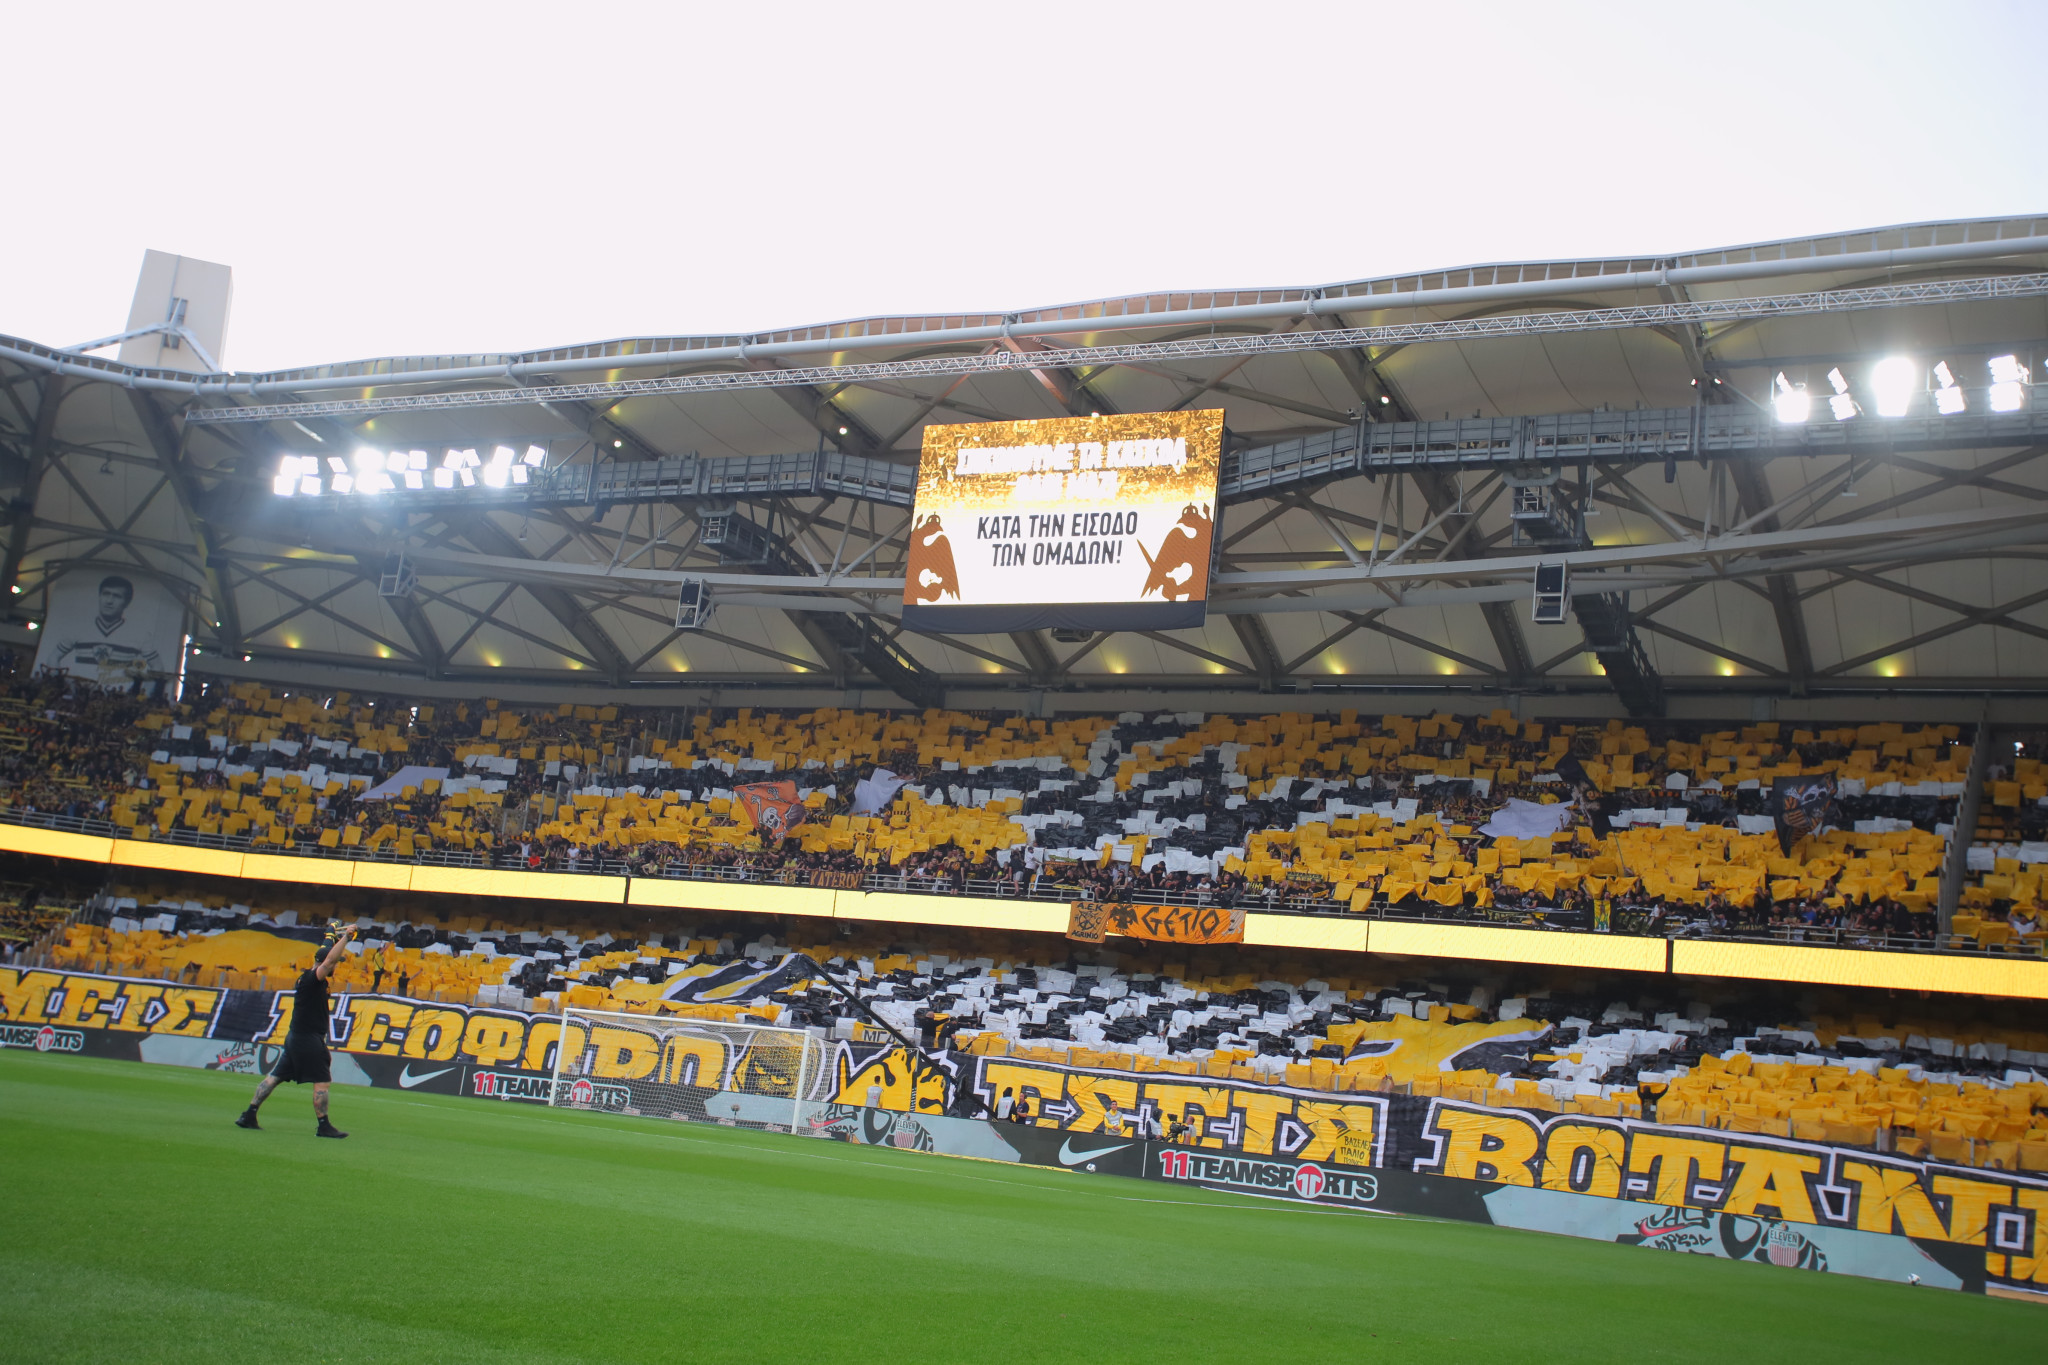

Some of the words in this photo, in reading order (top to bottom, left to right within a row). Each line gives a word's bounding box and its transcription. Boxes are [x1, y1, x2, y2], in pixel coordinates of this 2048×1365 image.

[977, 515, 1021, 539] ΚΑΤΑ
[1029, 513, 1065, 537] ΤΗΝ
[1071, 511, 1138, 537] ΕΙΣΟΔΟ
[992, 543, 1026, 566] ΤΩΝ
[1032, 540, 1122, 566] ΟΜΑΔΩΝ!
[1072, 930, 1099, 939] AGRINIO
[897, 1119, 916, 1129] ELEVEN
[1159, 1149, 1377, 1202] 11TEAMSPORTS
[1770, 1229, 1798, 1243] ELEVEN
